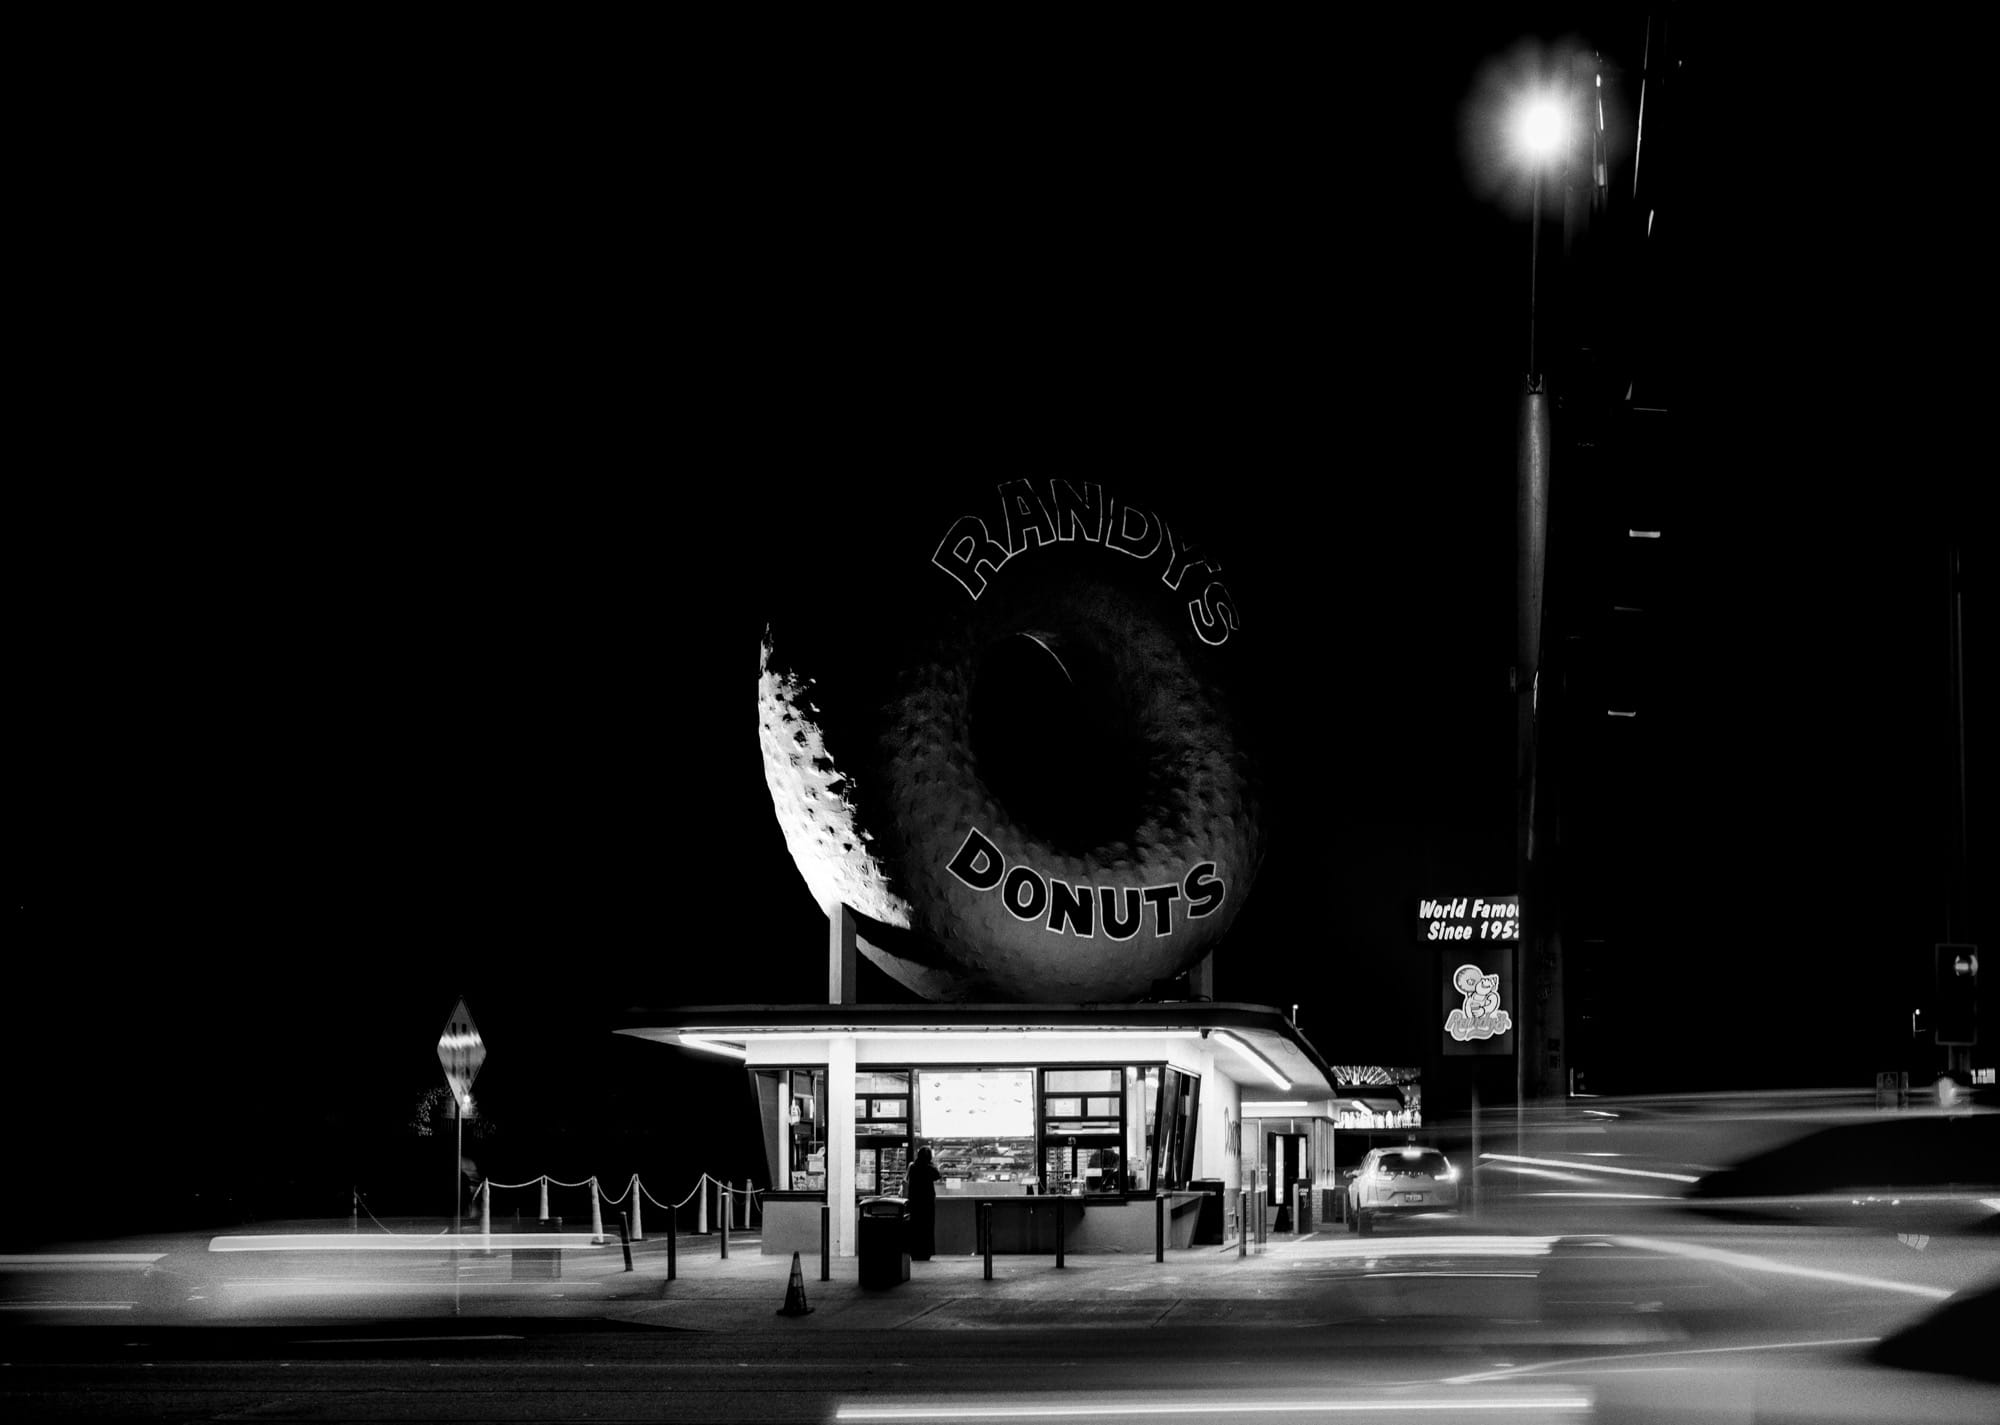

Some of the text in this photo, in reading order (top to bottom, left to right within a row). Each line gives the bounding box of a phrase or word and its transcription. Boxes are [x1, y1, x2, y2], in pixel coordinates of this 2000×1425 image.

[931, 477, 1240, 646] RANDY'S
[945, 826, 1225, 941] DONUTS
[1419, 897, 1468, 919] World
[1427, 920, 1473, 941] Since
